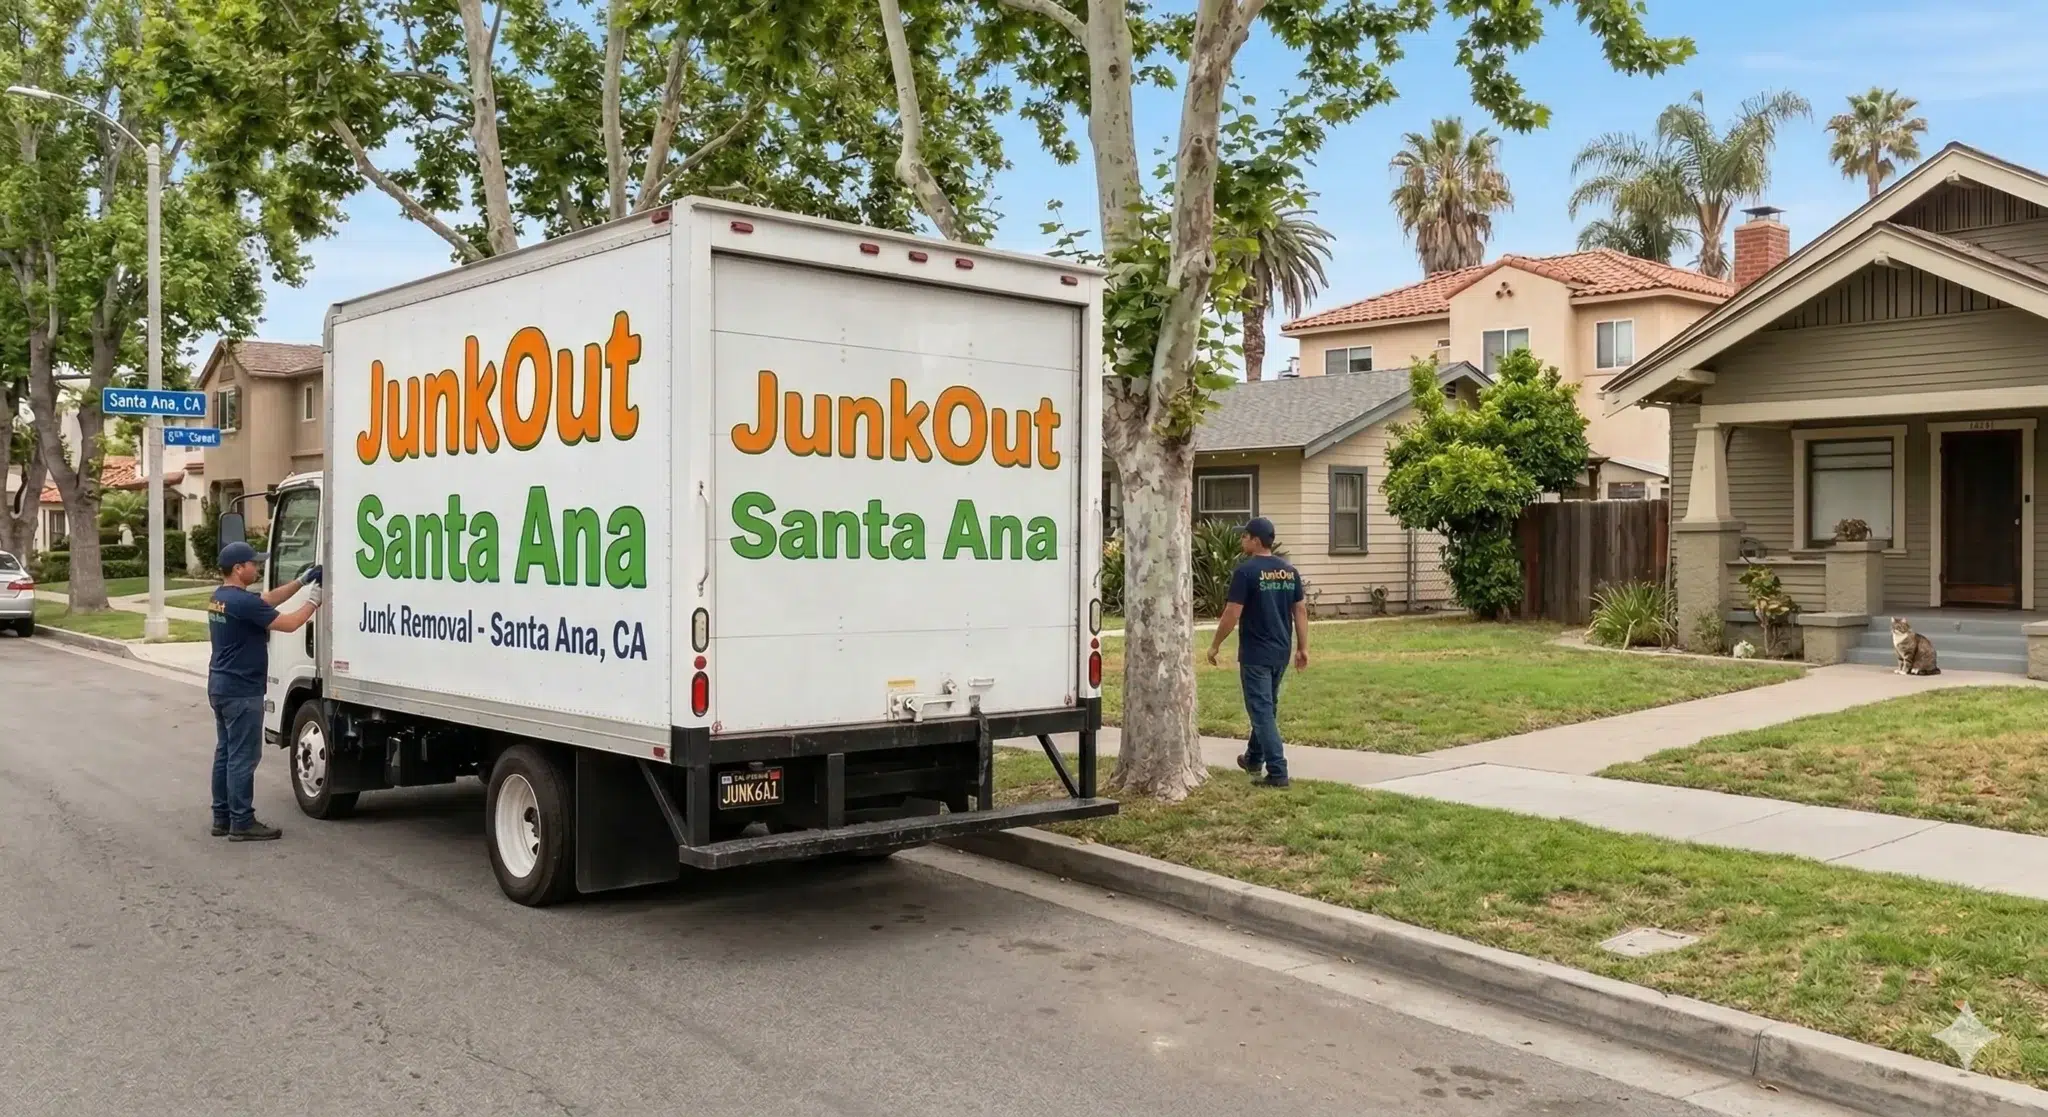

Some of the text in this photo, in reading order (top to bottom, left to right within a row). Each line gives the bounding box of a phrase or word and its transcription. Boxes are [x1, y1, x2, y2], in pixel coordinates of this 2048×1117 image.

[109, 392, 201, 412] Santa Ana, CA
[356, 310, 642, 466] JunkOut
[731, 369, 1062, 470] JunkOut
[355, 485, 648, 590] Santa Ana
[729, 491, 1059, 562] Santa Ana
[359, 601, 397, 635] Junk
[401, 604, 473, 644] Removal
[490, 611, 549, 651] Santa
[554, 616, 606, 664] Ana,
[612, 619, 648, 661] CA
[722, 780, 779, 804] JUNK6A1
